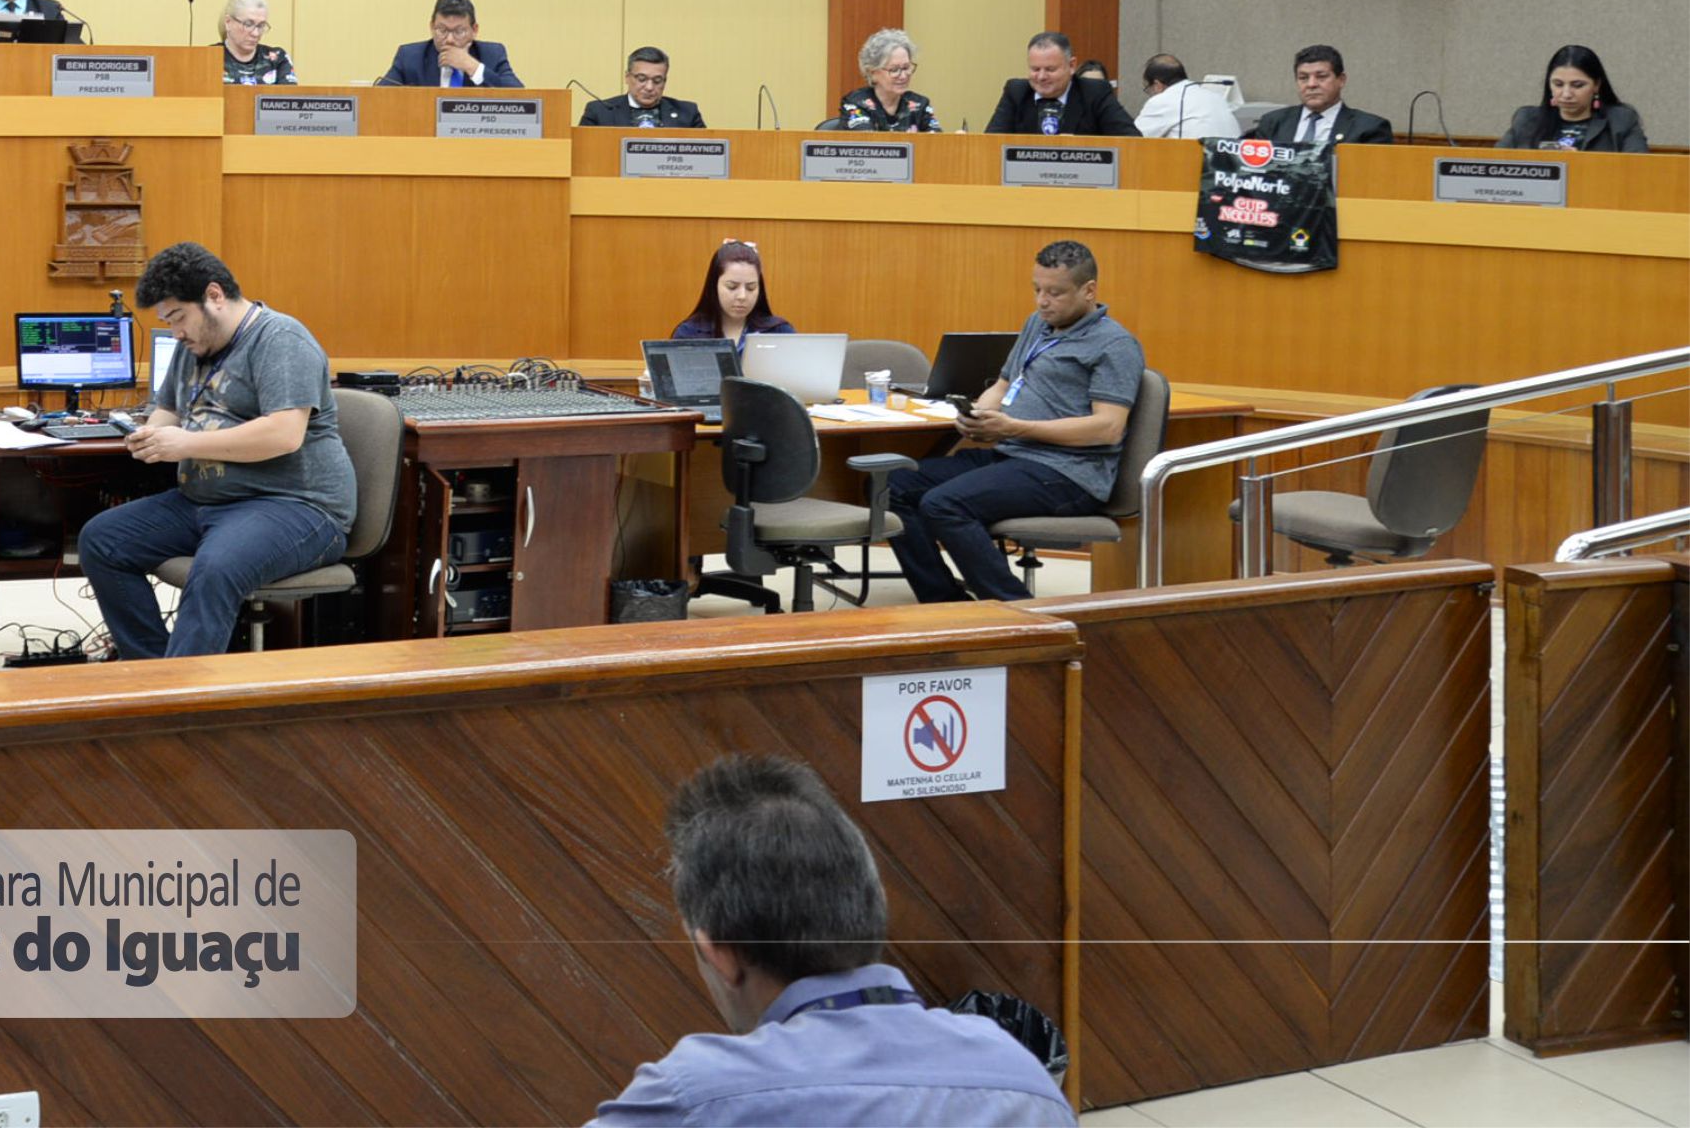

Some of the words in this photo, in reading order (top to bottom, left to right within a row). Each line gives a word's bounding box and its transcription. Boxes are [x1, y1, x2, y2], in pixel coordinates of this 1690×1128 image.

[66, 61, 87, 70] BENI
[88, 62, 139, 70] RODRIGUES
[302, 102, 350, 110] ANDREOLA
[452, 103, 479, 112] JOÃO
[481, 104, 525, 112] MIRANDA
[813, 146, 836, 155] INÊS
[839, 148, 900, 156] WEIZEMANN
[1017, 151, 1058, 160] MARINO
[1060, 152, 1102, 161] GARCIA
[1217, 140, 1294, 161] NISSEI
[1450, 164, 1486, 175] ANICE
[1489, 167, 1551, 177] GAZZAOUI
[1215, 171, 1290, 194] PolpaNorte
[1234, 197, 1268, 211] CUP
[899, 681, 926, 695] POR
[930, 678, 972, 693] FAVOR
[887, 776, 933, 786] MANTENHA
[935, 774, 941, 782] O
[944, 771, 981, 782] CELULAR
[903, 787, 915, 796] NO
[917, 784, 966, 795] SILENCIOSO
